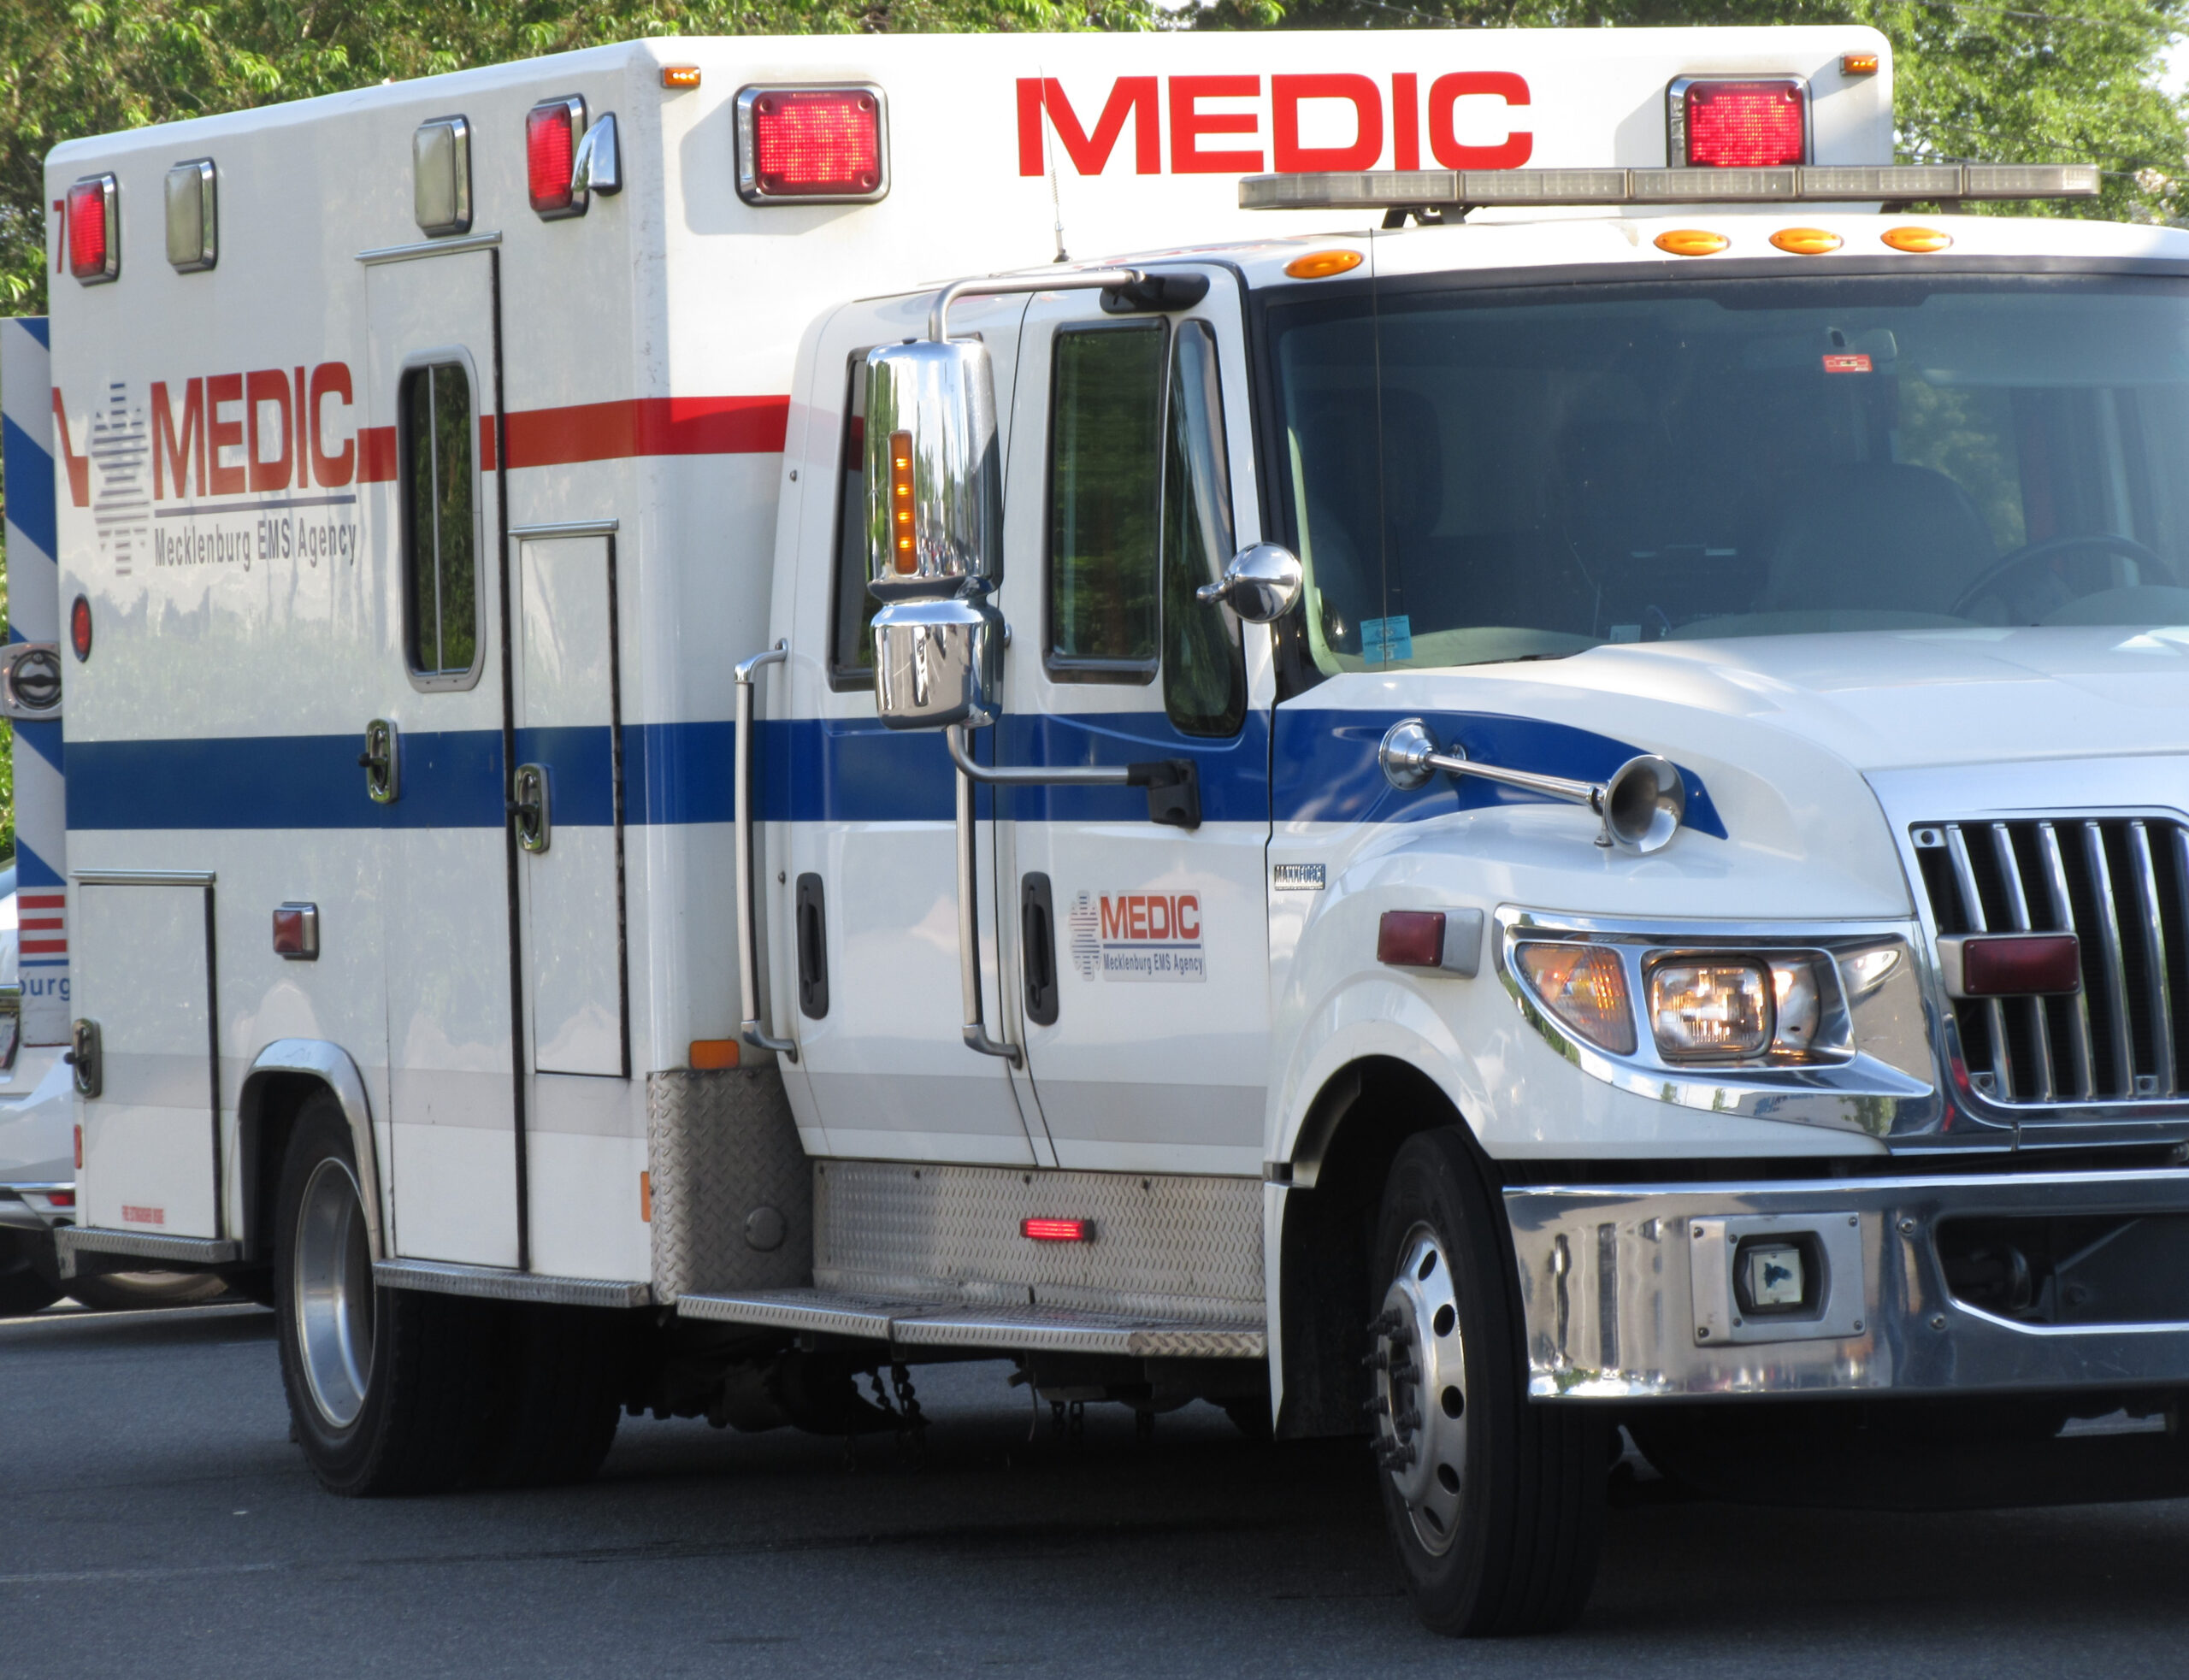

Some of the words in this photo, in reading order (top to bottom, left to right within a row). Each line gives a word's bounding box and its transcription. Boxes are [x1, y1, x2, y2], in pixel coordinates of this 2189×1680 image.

[1016, 71, 1532, 176] MEDIC
[150, 361, 355, 500] MEDIC
[155, 523, 251, 572] Mecklenburg
[257, 517, 291, 560] EMS
[298, 517, 357, 567] Agency
[1100, 895, 1201, 940] MEDIC
[1103, 953, 1152, 976] Mecklenburg
[1154, 953, 1171, 971] EMS
[1174, 953, 1203, 976] Agency
